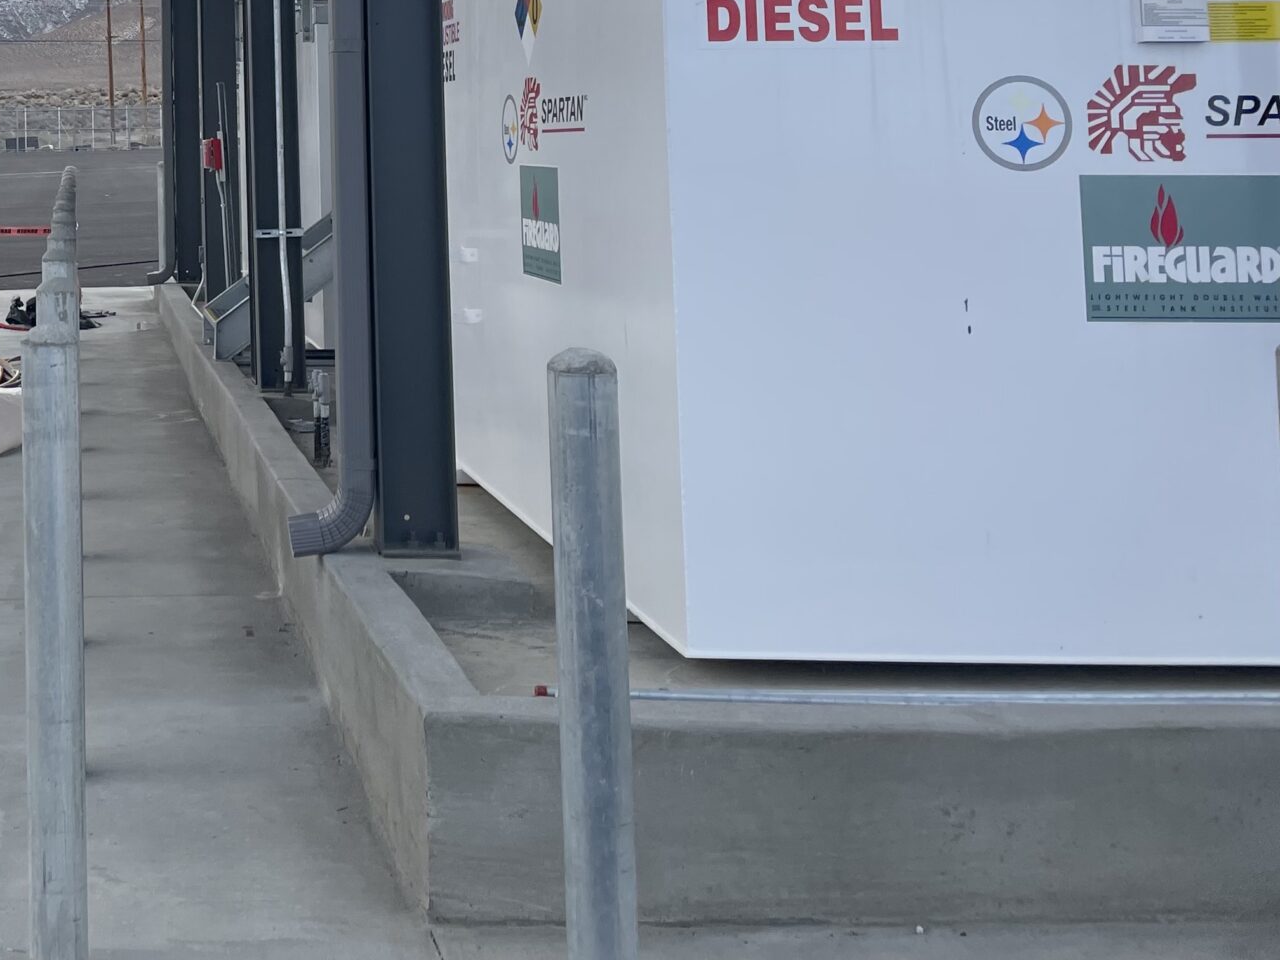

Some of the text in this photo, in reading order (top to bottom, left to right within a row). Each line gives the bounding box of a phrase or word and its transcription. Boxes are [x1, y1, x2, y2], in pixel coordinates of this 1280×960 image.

[541, 95, 584, 124] SPARTAN
[1204, 94, 1280, 127] SPA
[985, 115, 1017, 132] Steel
[1090, 294, 1184, 302] LIGHTWEIGHT
[1193, 294, 1244, 302] DOUBLE
[1106, 305, 1147, 313] STEEL
[1161, 305, 1197, 313] TANK
[1211, 305, 1280, 313] INSTITUT
